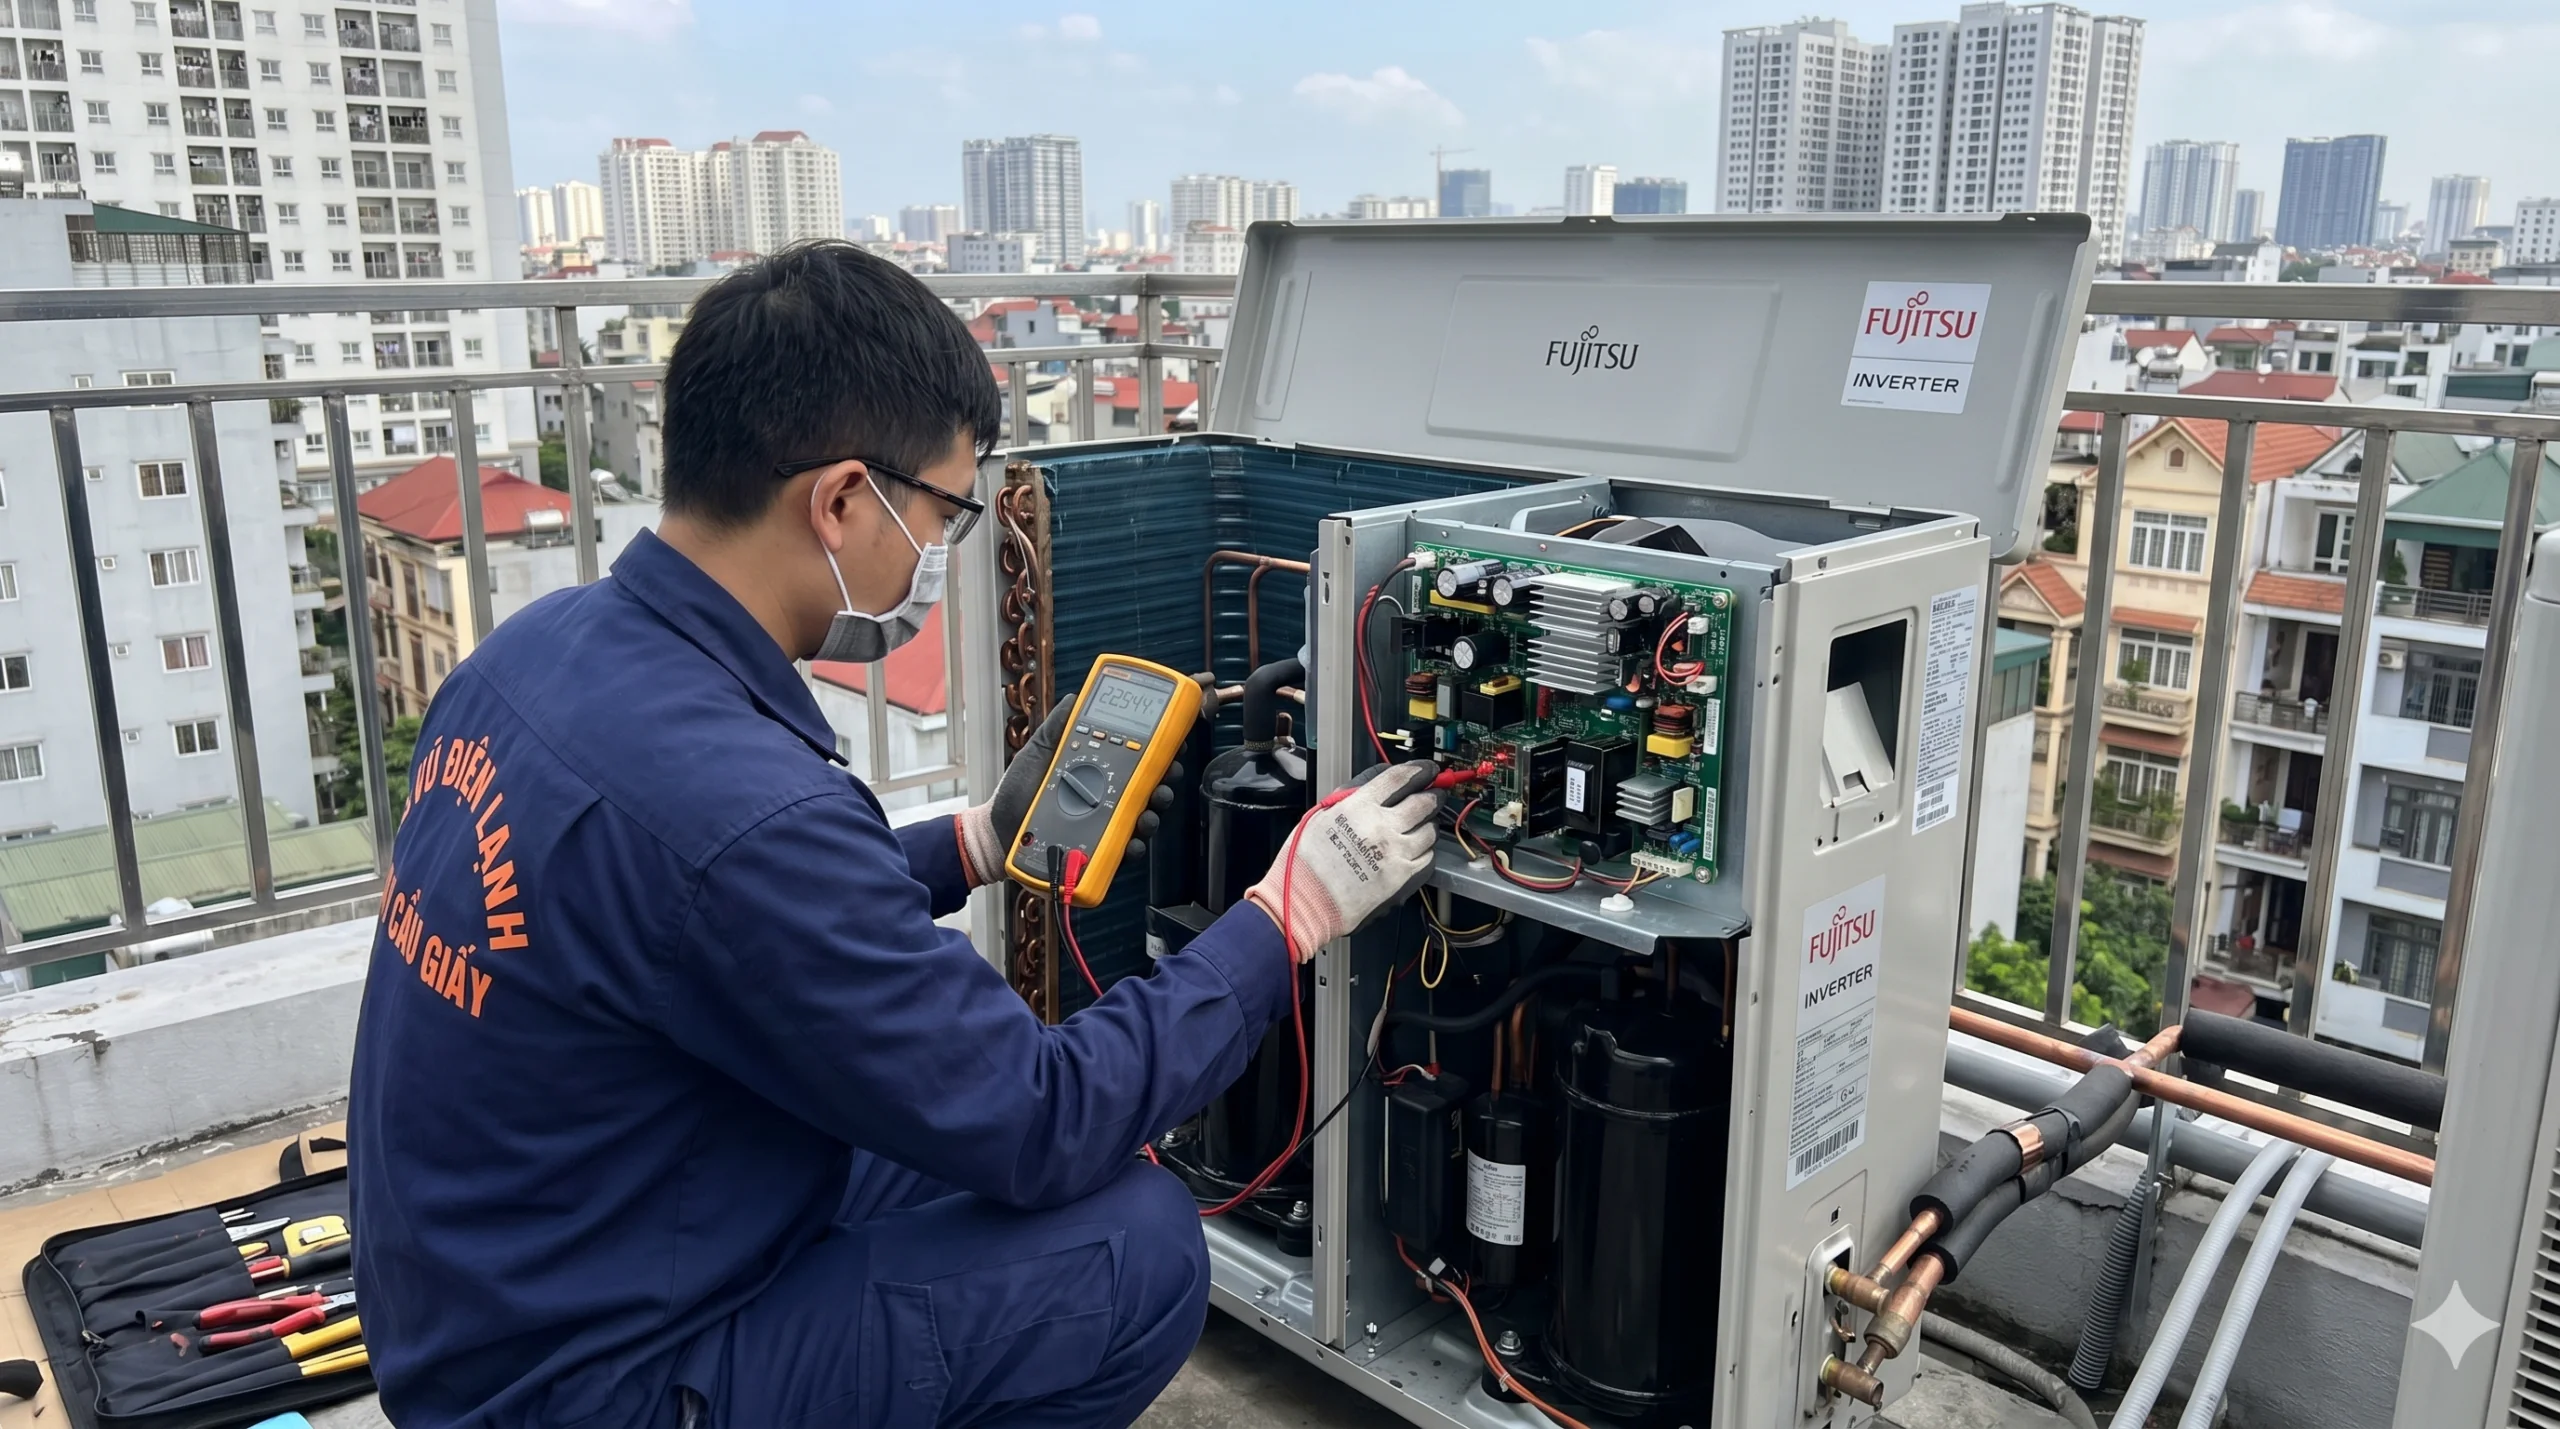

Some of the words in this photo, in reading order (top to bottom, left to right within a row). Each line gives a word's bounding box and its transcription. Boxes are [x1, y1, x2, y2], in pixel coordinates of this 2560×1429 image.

[1864, 290, 1977, 345] FUJITSU
[1545, 324, 1640, 376] FUJITSU
[1852, 373, 1960, 394] INVERTER
[441, 735, 497, 814] ĐIỆN
[472, 792, 529, 951] LẠNH
[1808, 905, 1876, 966] FUJITSU
[420, 935, 493, 1019] GIẤY
[1804, 963, 1873, 1010] INVERTER
